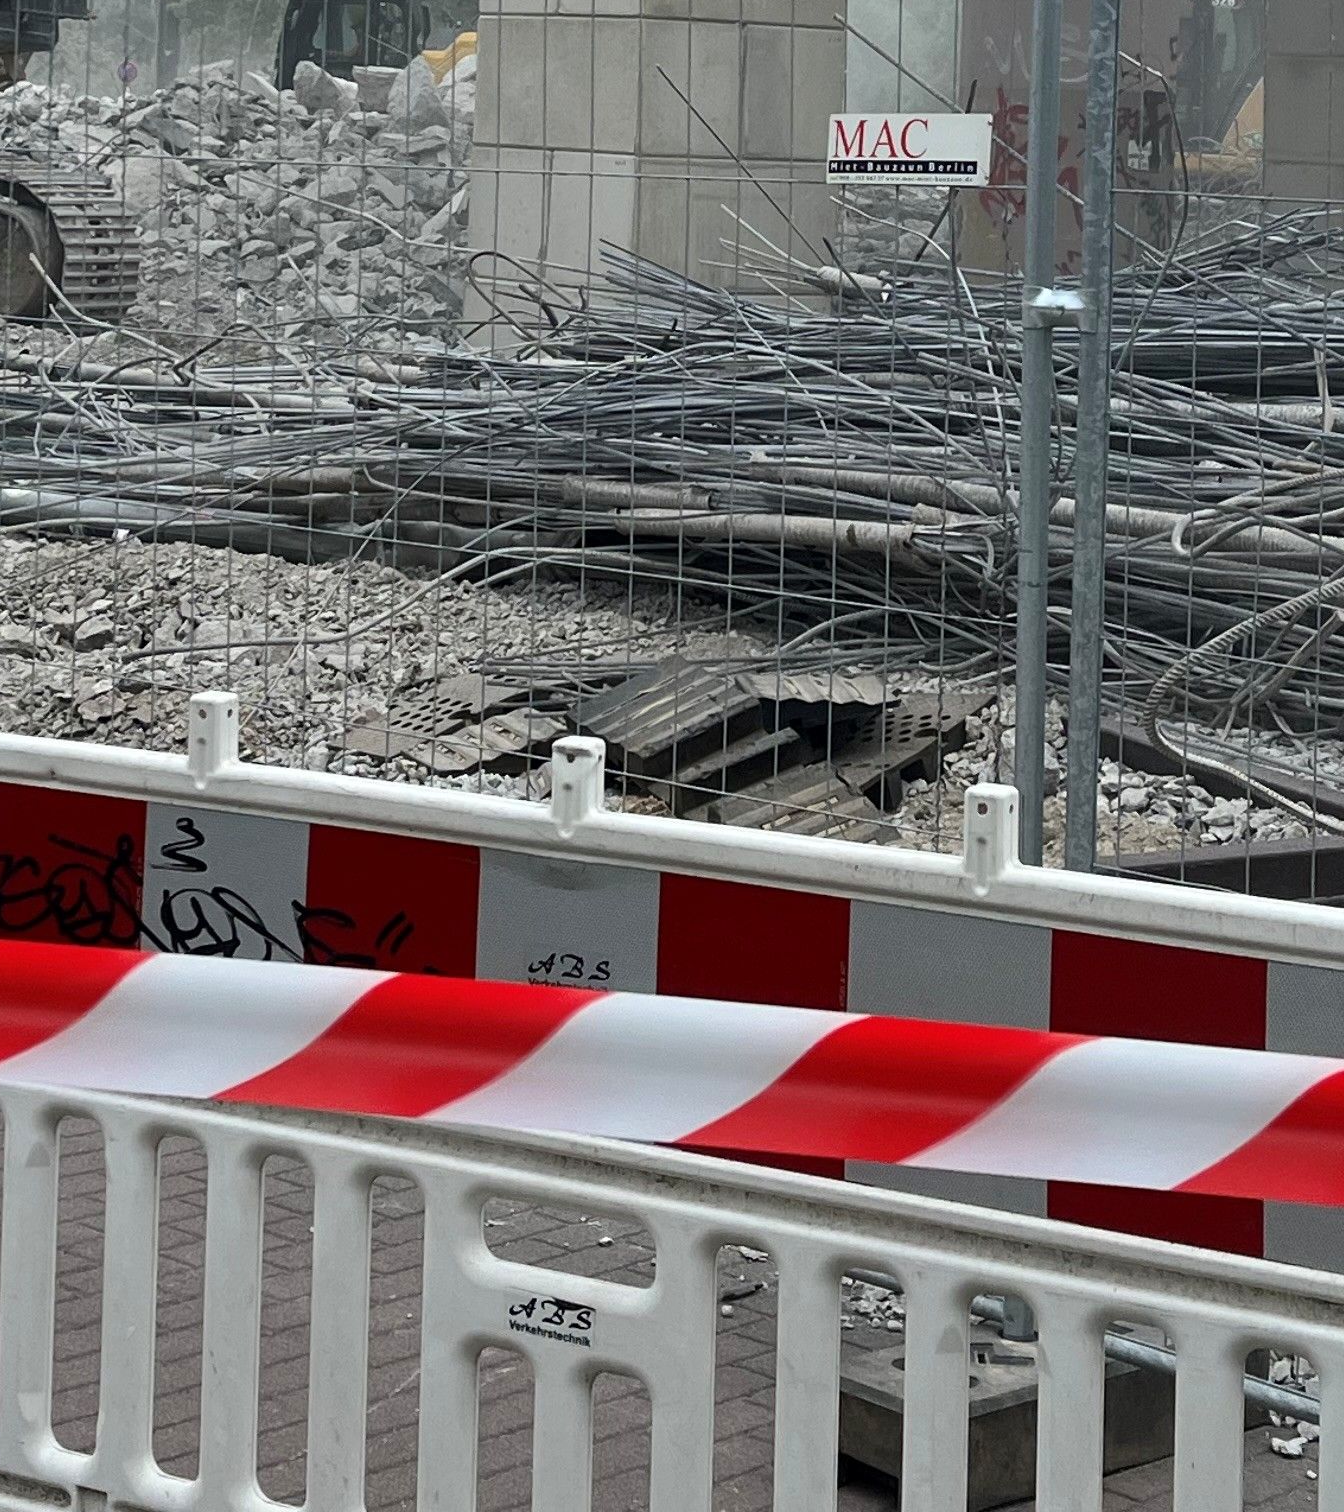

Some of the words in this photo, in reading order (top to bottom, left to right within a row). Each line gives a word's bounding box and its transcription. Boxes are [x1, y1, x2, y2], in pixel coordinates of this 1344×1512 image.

[833, 118, 929, 159] MAC
[927, 162, 977, 173] Berlin
[527, 952, 611, 981] ABS
[509, 1297, 592, 1330] ABS
[509, 1319, 592, 1348] Verkehrstechnik
